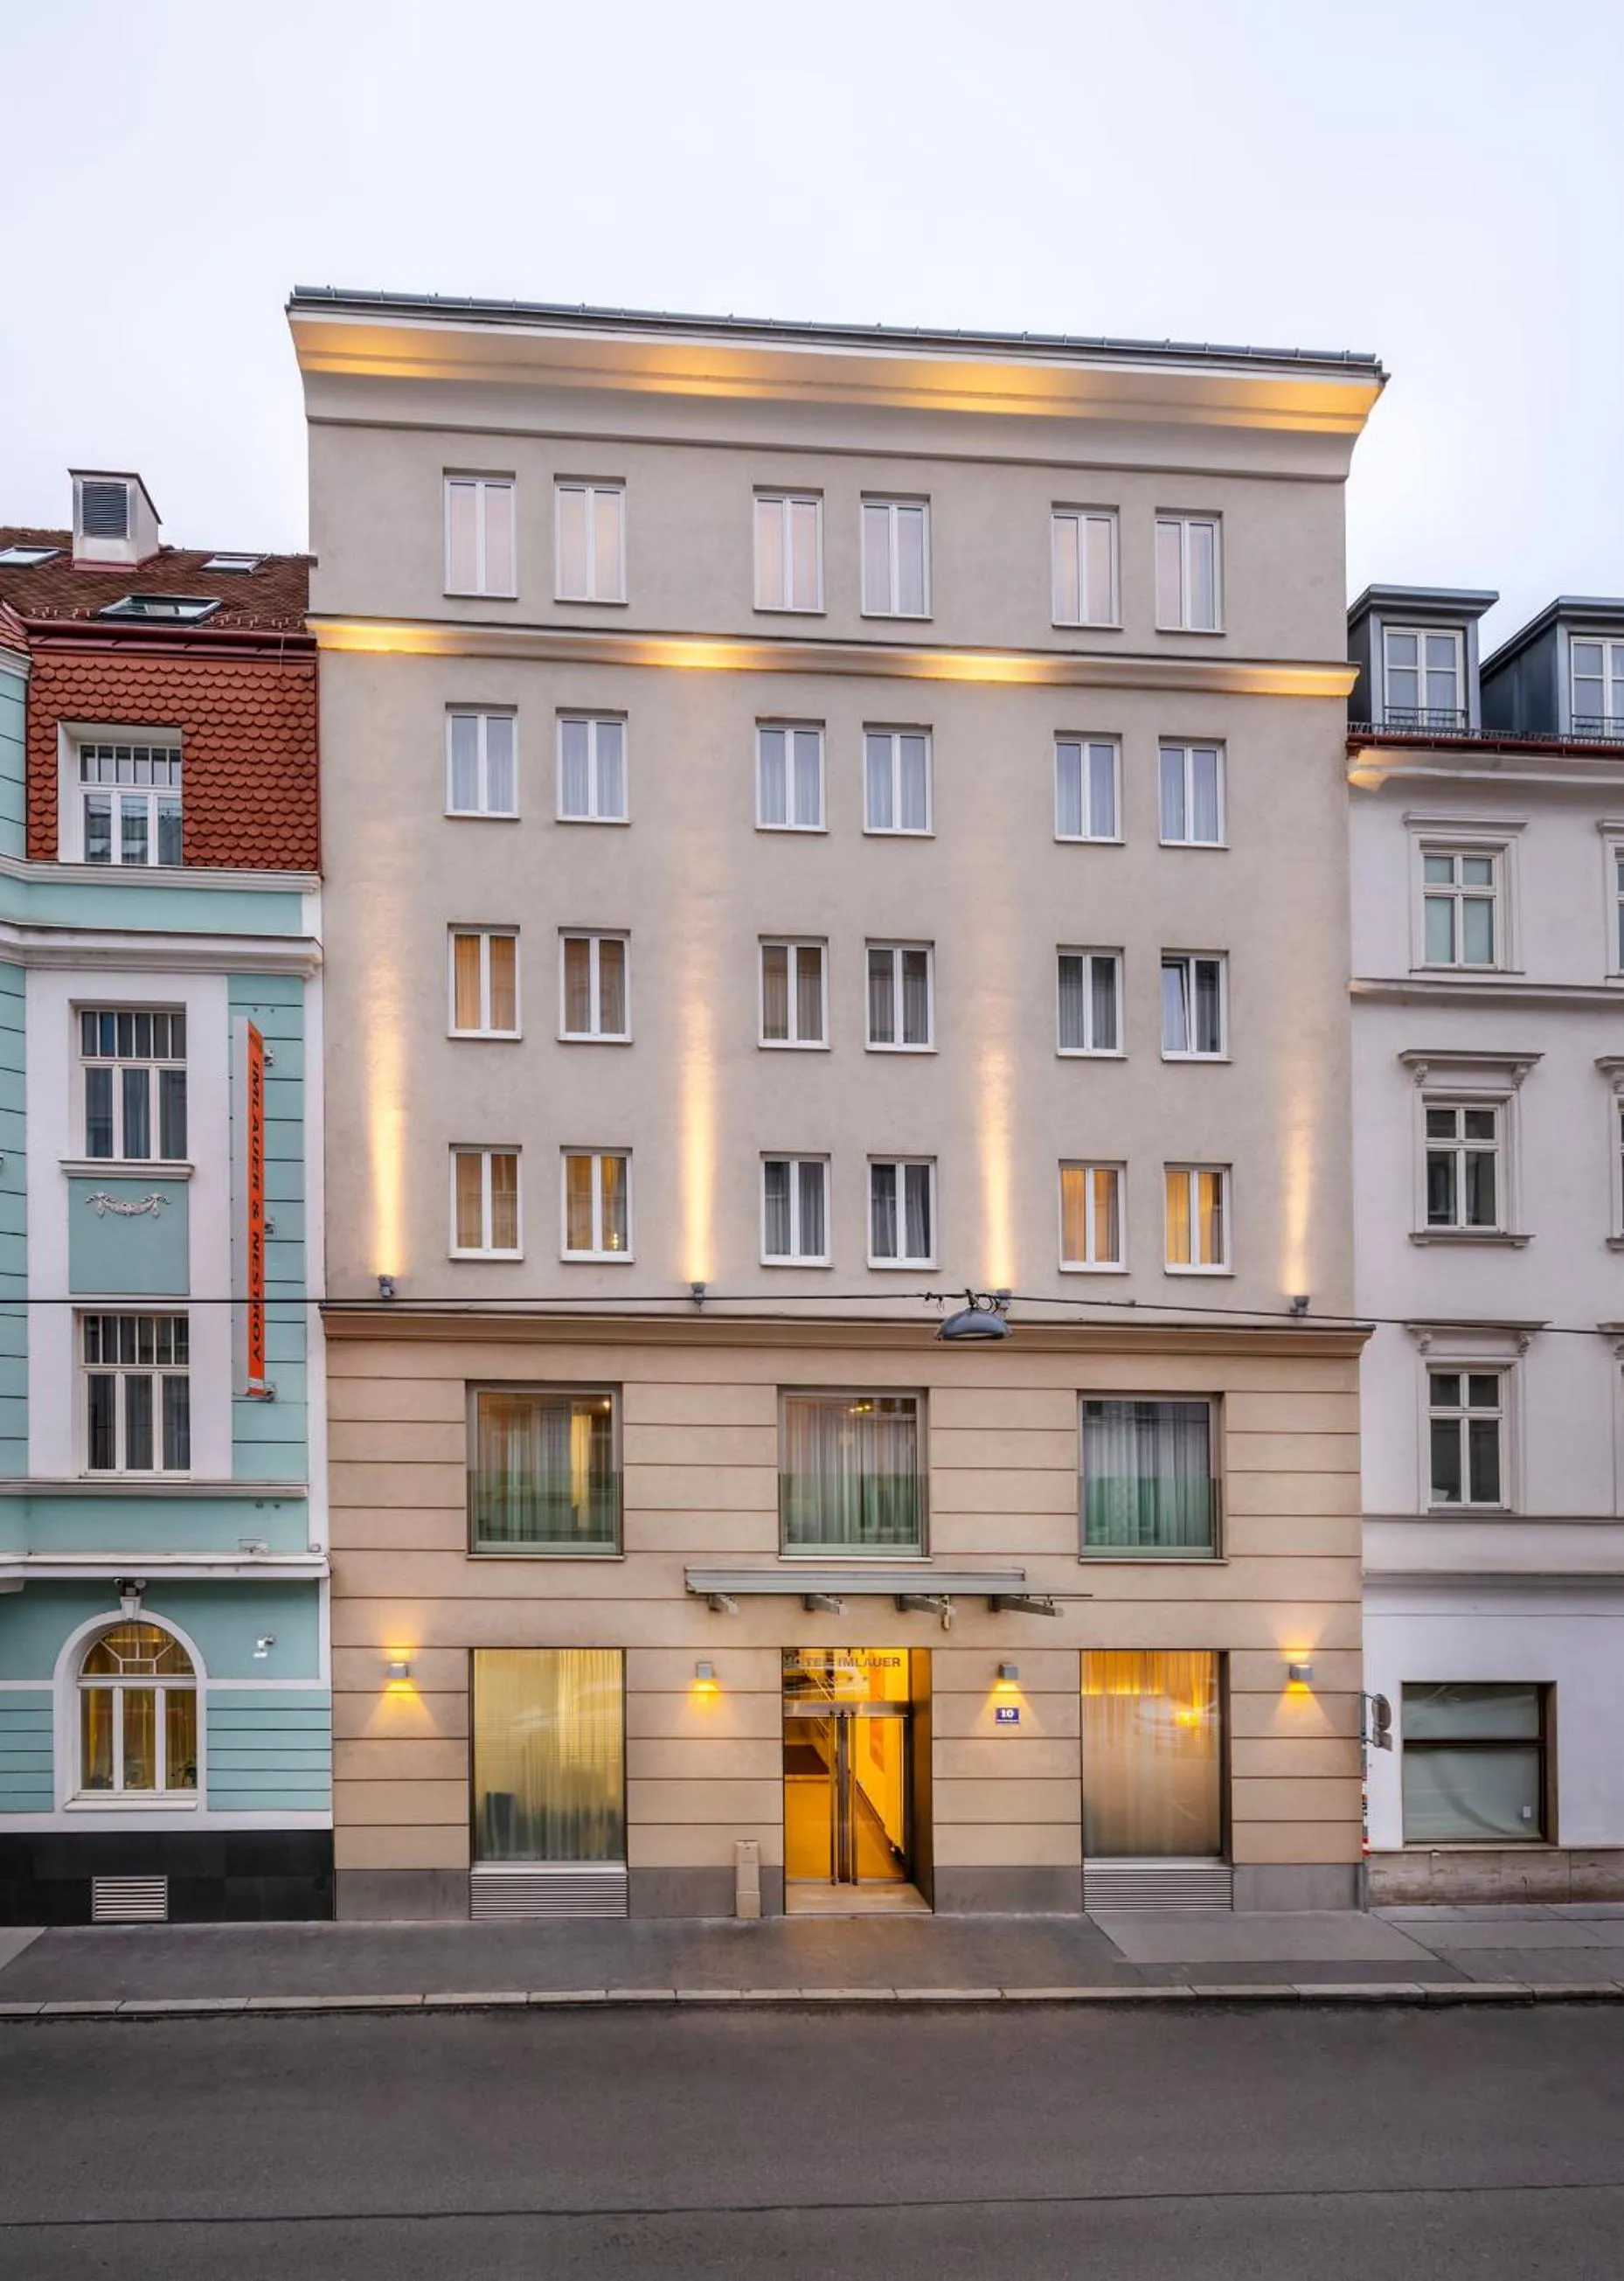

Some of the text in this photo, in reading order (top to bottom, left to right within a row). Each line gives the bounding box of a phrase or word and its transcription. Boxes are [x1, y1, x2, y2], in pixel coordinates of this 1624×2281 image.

[252, 1060, 260, 1192] IMLAUER
[253, 1200, 260, 1218] &
[839, 1658, 901, 1667] IMLAUER
[1001, 1709, 1014, 1718] 10
